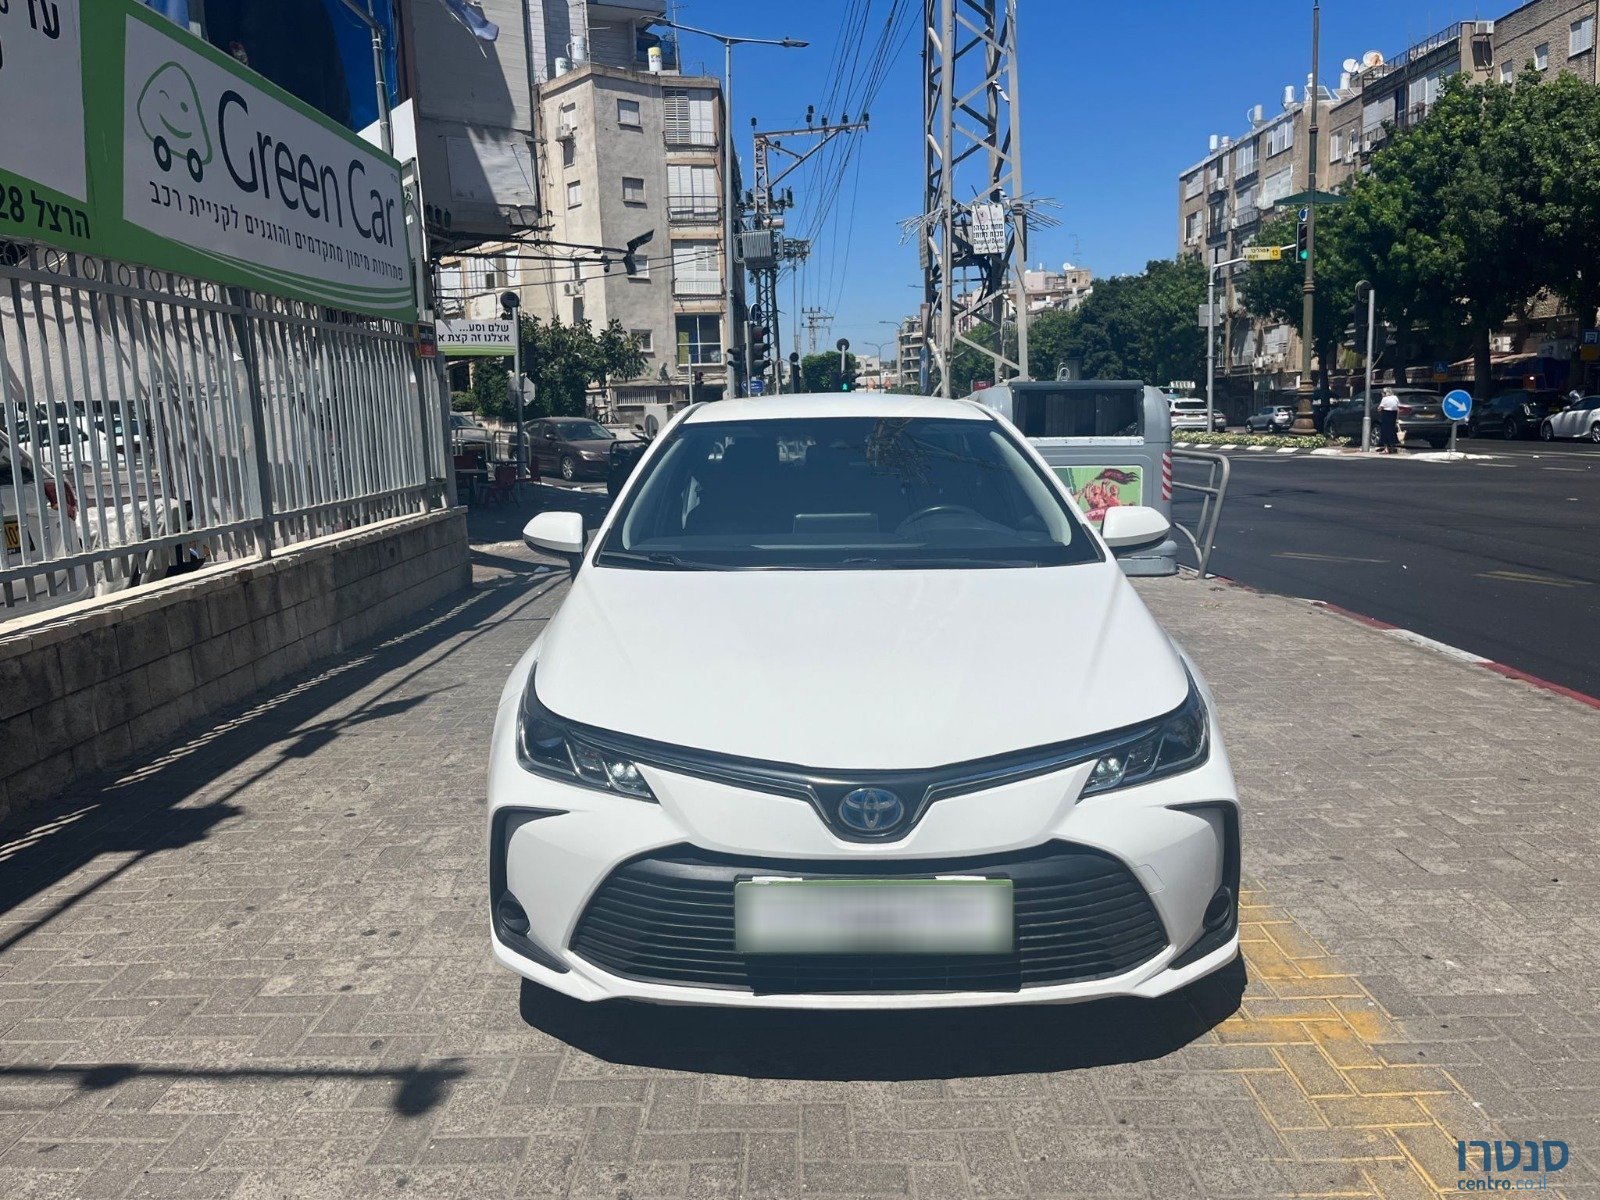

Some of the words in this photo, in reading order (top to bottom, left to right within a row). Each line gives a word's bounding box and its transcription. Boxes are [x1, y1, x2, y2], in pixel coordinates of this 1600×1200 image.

[218, 90, 343, 228] Green
[348, 159, 395, 247] Car
[149, 181, 182, 212] רכב
[30, 189, 91, 239] הרצל
[188, 193, 239, 232] לקניית
[245, 214, 291, 247] והוגנים
[294, 231, 344, 263] מתקדמים
[346, 248, 371, 272] מימון
[372, 257, 403, 281] פתרונות
[447, 333, 468, 344] קצת
[459, 323, 485, 332] וסע...
[471, 334, 481, 342] זה
[484, 333, 510, 342] אצלנו
[488, 323, 509, 332] שלם
